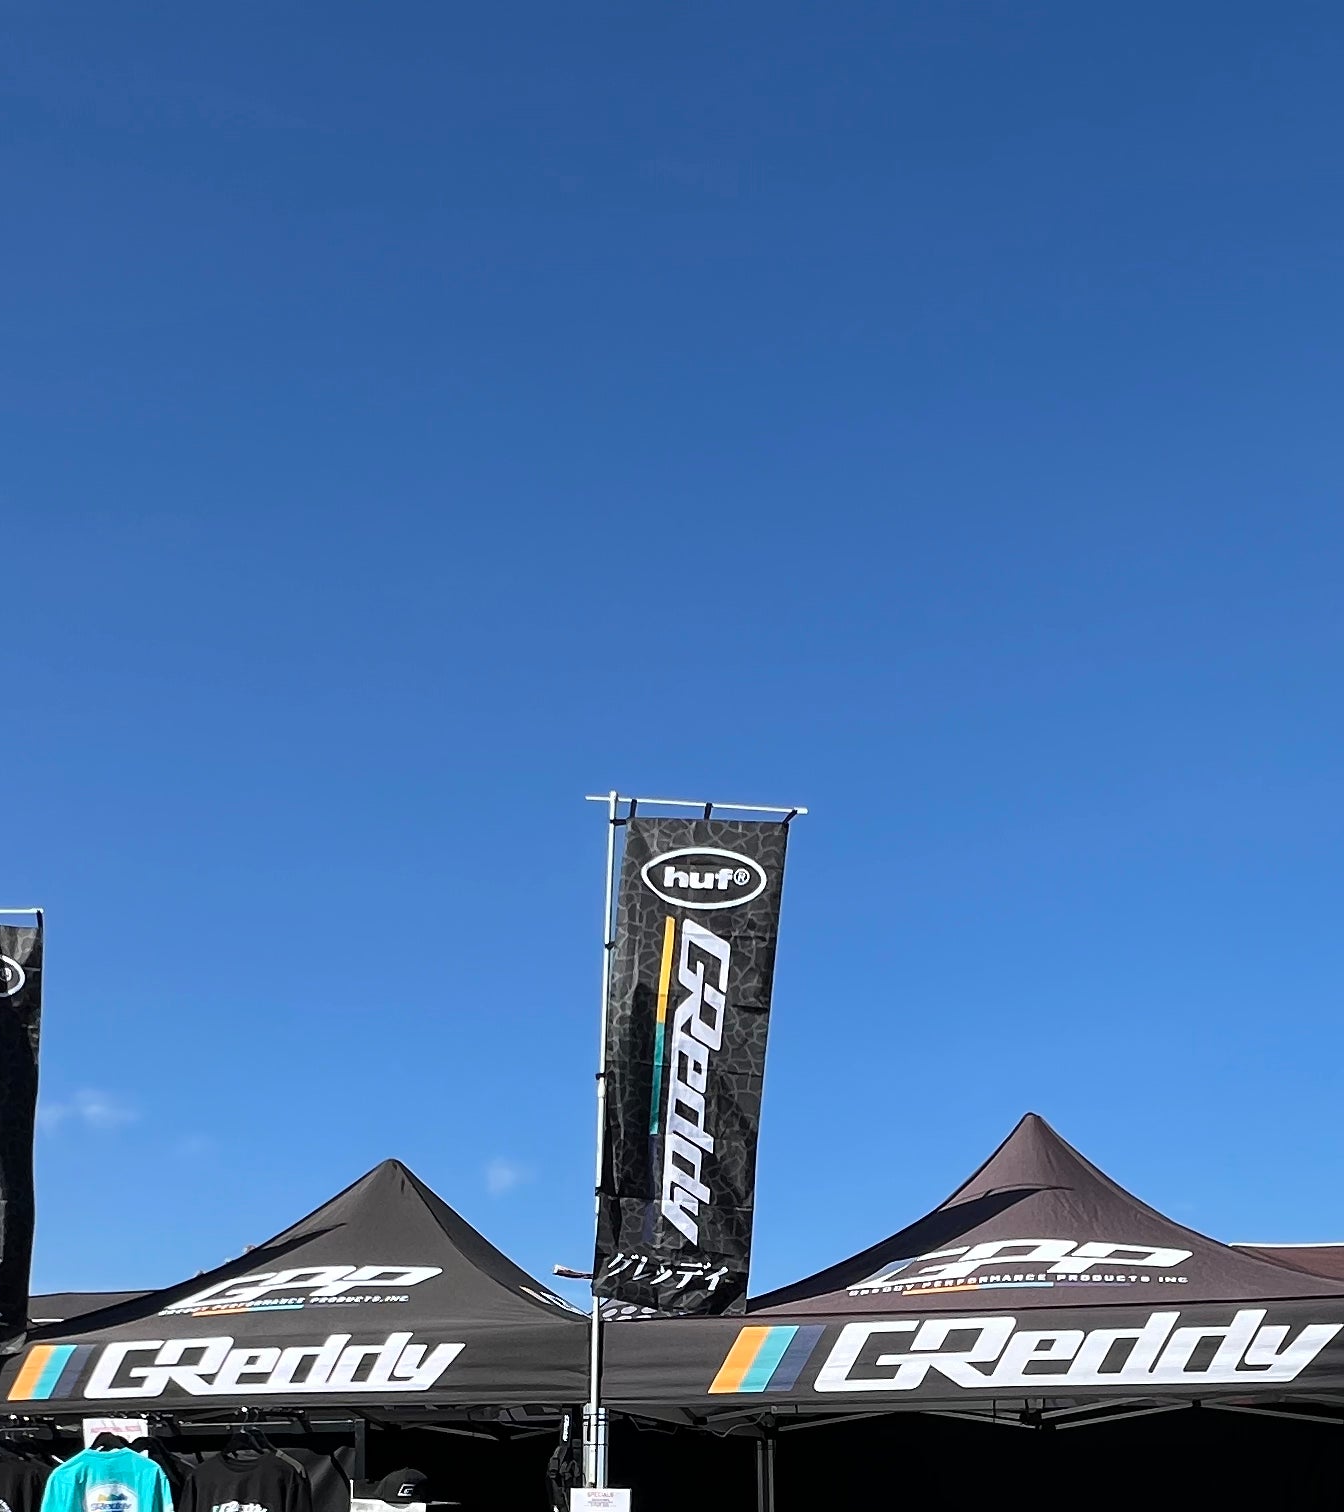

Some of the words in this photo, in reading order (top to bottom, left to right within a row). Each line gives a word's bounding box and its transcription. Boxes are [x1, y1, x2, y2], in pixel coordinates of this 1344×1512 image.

[661, 918, 732, 1246] GReddy
[922, 1273, 1047, 1288] PERFORMANCE
[1056, 1273, 1150, 1284] PRODUCTS
[83, 1332, 467, 1400] GReddy
[813, 1309, 1344, 1393] GReddy
